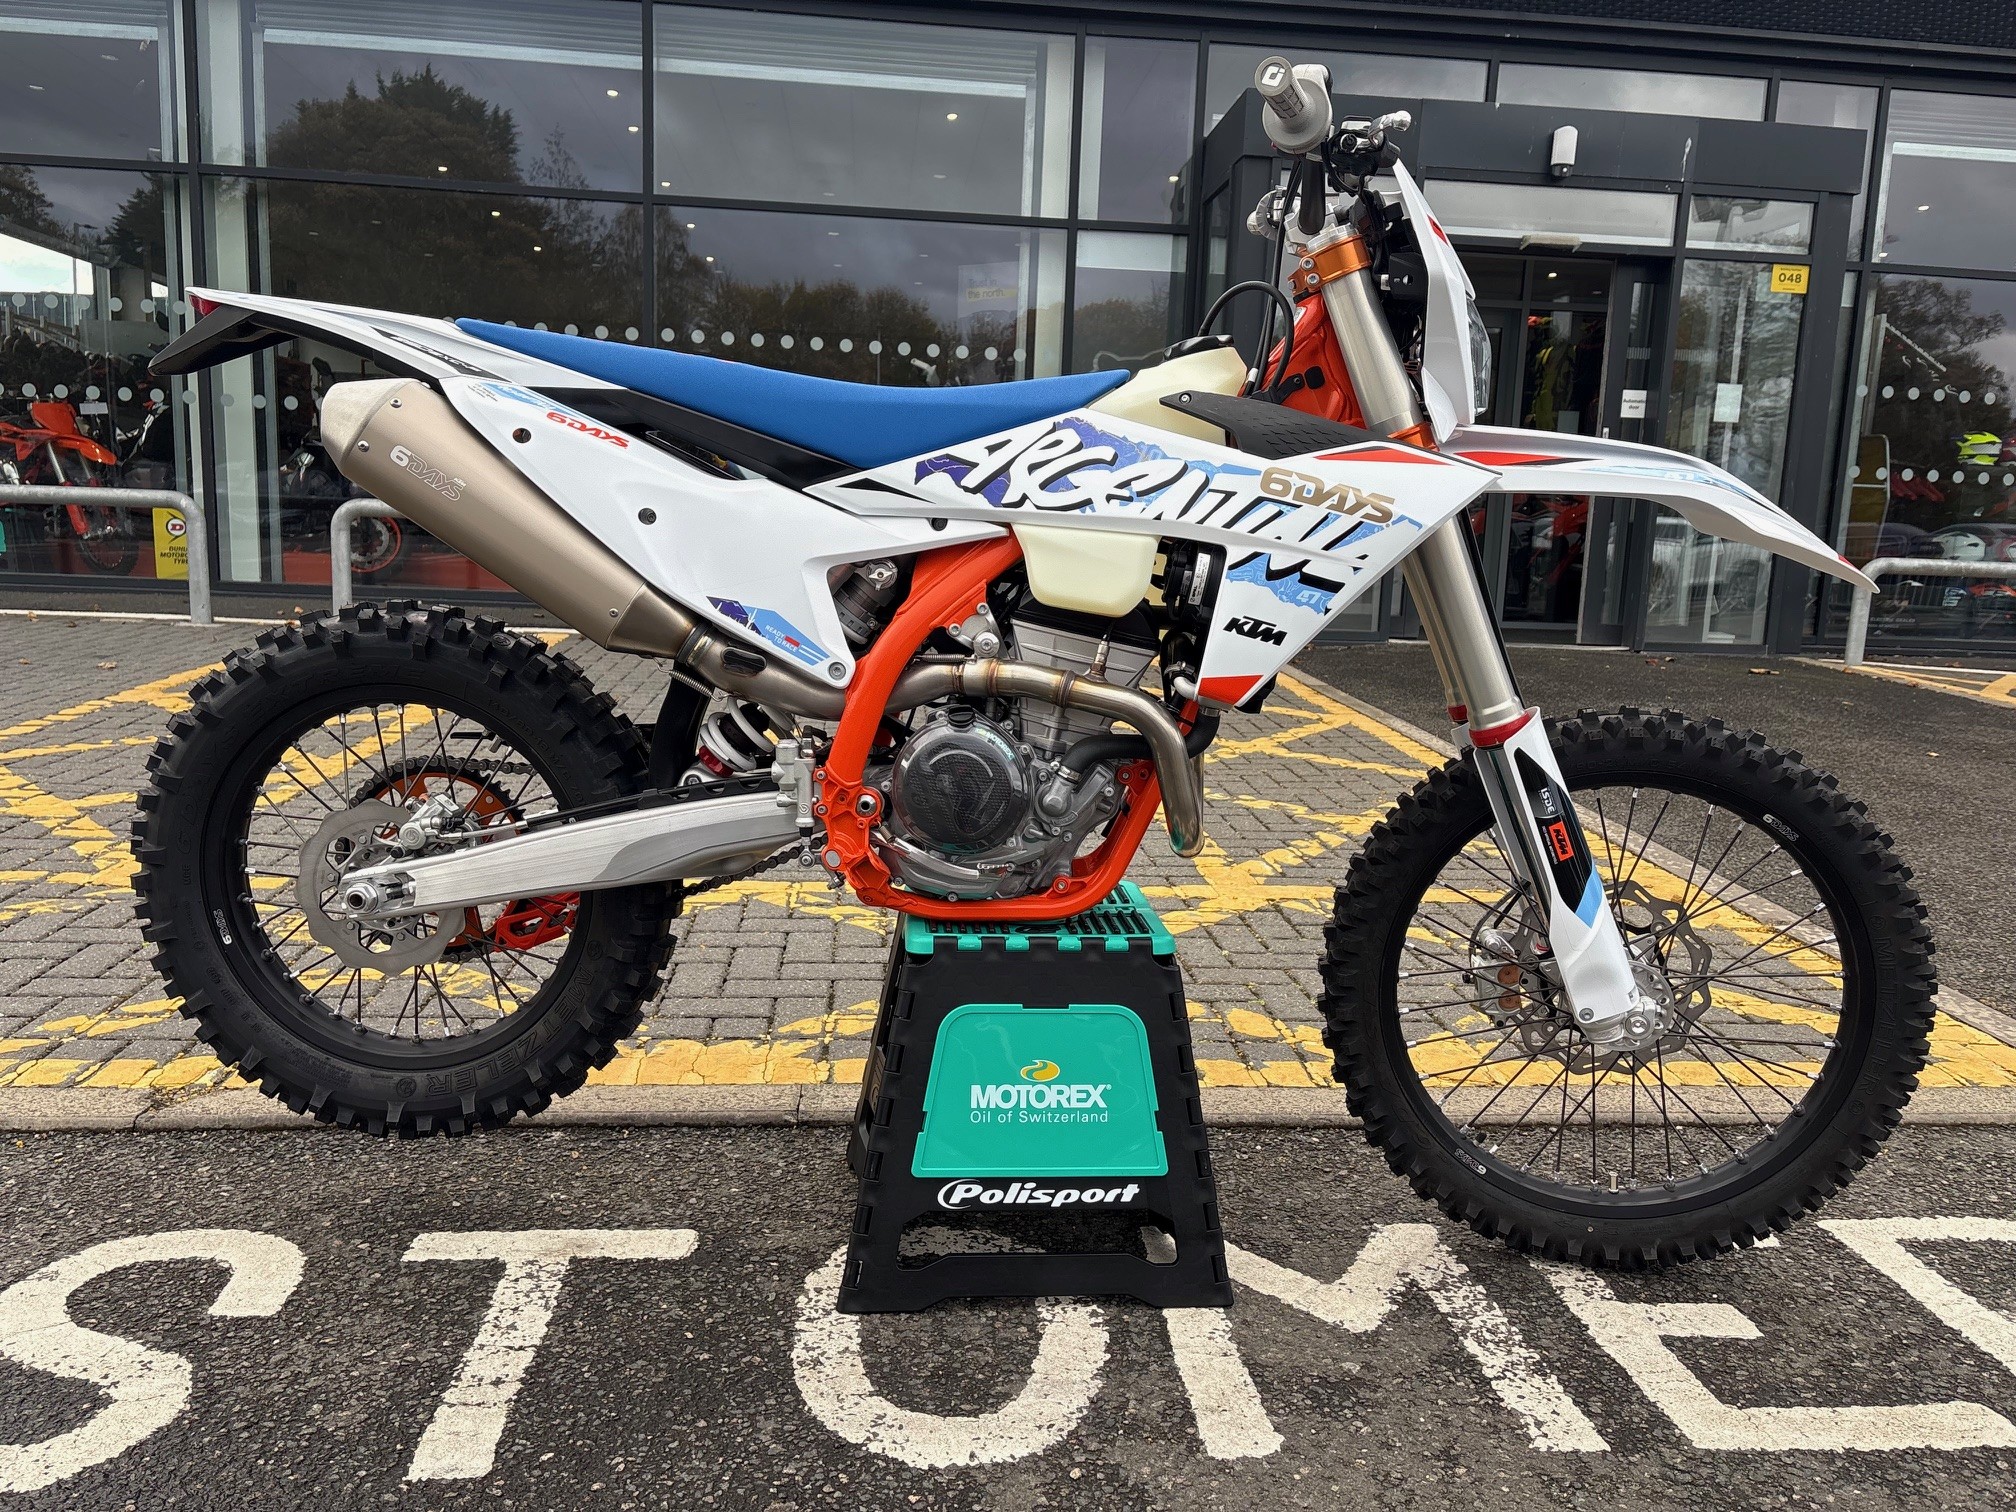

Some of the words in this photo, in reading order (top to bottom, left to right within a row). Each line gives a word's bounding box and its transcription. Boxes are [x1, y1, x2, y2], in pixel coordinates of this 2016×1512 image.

[1778, 273, 1802, 284] 048
[968, 290, 981, 299] the
[1259, 466, 1395, 525] 6DAYS
[766, 625, 785, 638] READY
[1222, 615, 1288, 647] KTM
[782, 641, 798, 652] RACE
[1552, 828, 1569, 856] KTM
[424, 965, 595, 1096] METZELER
[970, 1084, 1109, 1109] MOTOREX
[970, 1110, 991, 1123] Oil
[998, 1110, 1013, 1123] of
[1018, 1109, 1109, 1124] Switzerland
[938, 1178, 1140, 1209] Polisport
